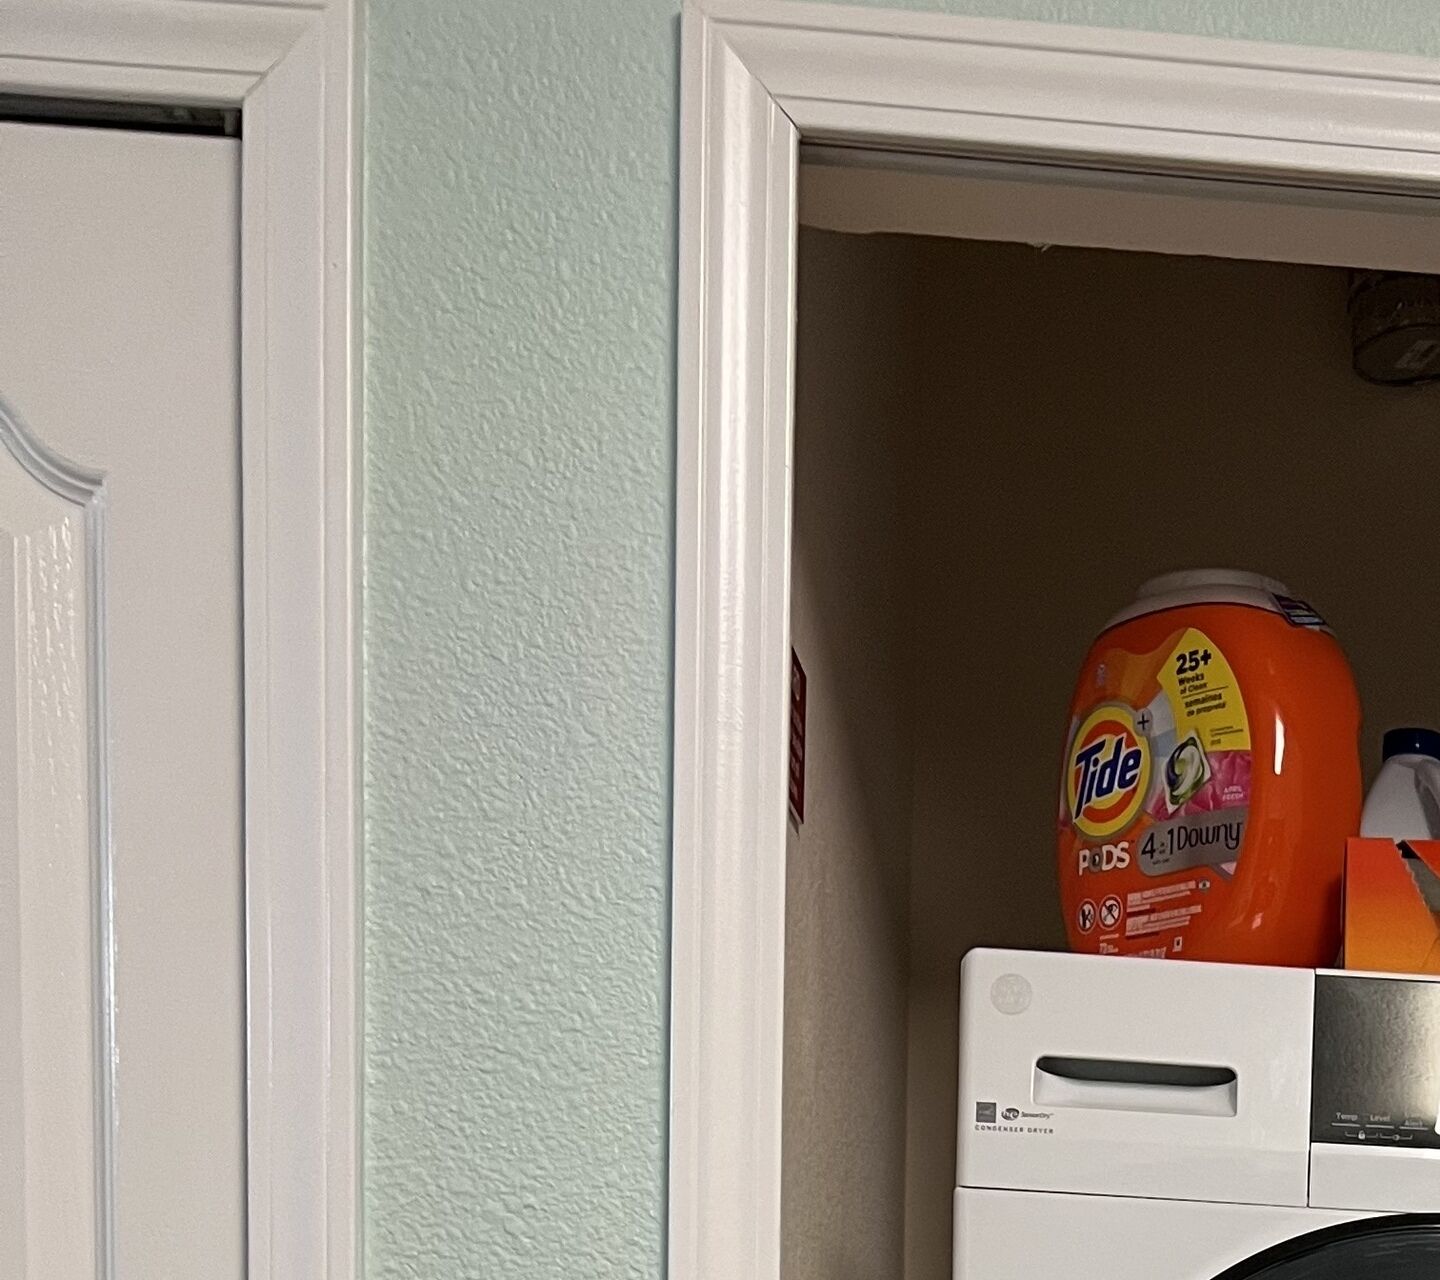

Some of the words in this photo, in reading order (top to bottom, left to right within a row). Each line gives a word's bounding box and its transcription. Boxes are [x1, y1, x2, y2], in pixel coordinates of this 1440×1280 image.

[1176, 649, 1211, 675] 25+
[1073, 735, 1143, 821] Tide
[1141, 832, 1156, 859] 4
[1177, 821, 1243, 850] Downy
[1079, 842, 1131, 876] PODS
[1335, 1112, 1358, 1121] Temp
